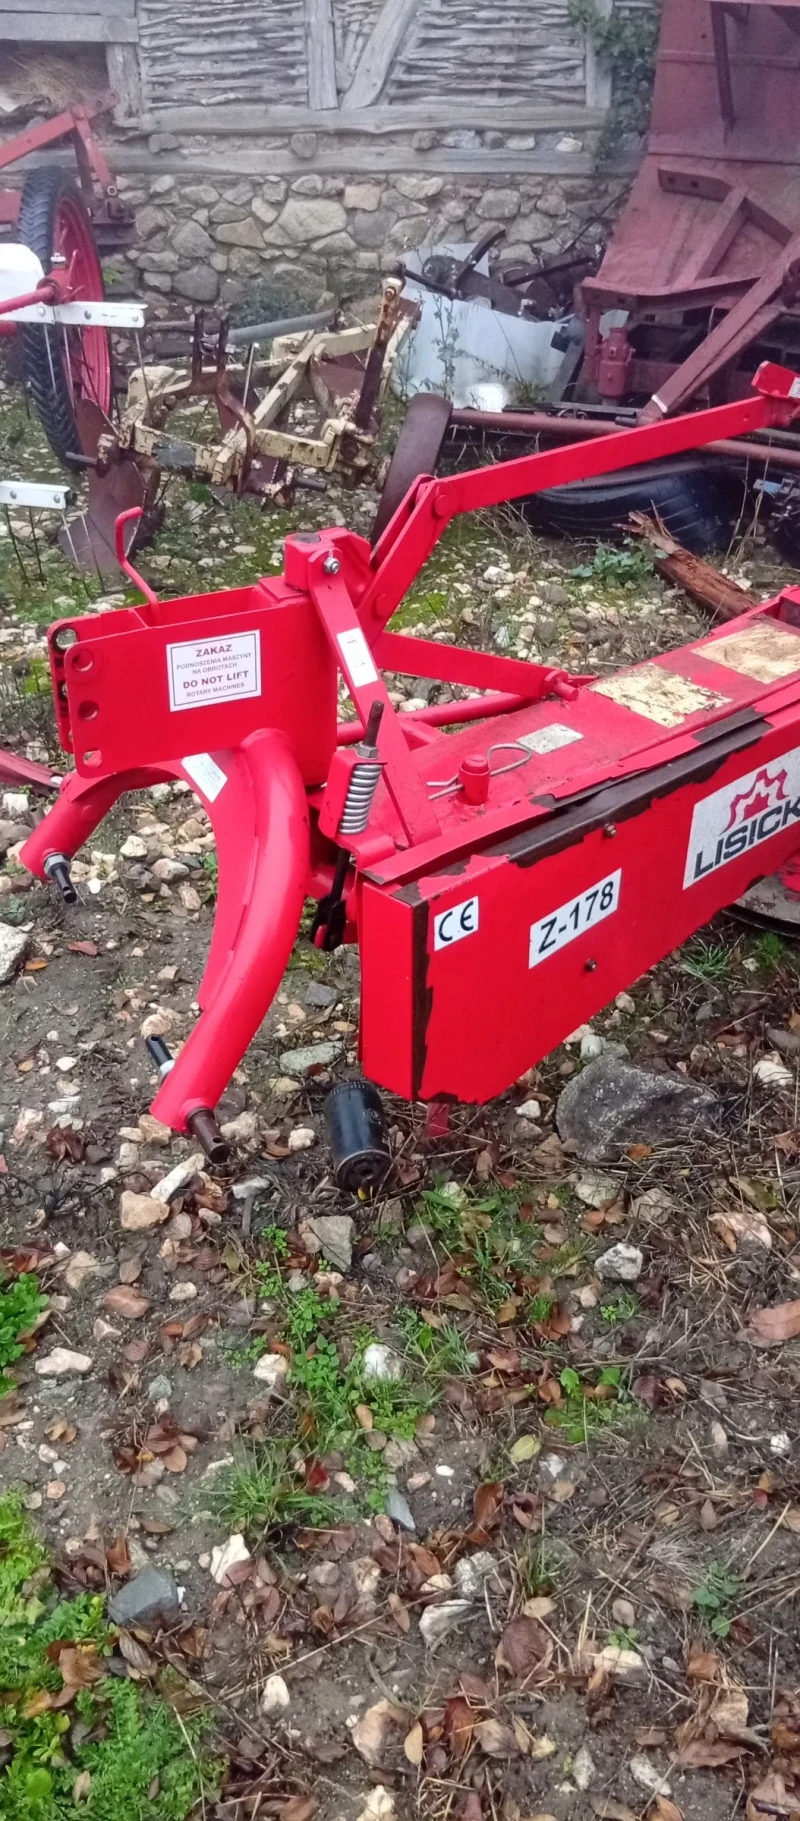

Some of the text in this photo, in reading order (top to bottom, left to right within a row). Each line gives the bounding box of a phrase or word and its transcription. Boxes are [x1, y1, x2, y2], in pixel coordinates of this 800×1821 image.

[195, 644, 232, 657] ZAKAZ
[222, 652, 252, 662] MASZYNY
[202, 662, 238, 673] OBROTACH
[183, 670, 249, 689] DO NOT LIFT
[212, 682, 245, 692] MACHINES
[693, 796, 800, 880] LISICK
[538, 881, 614, 954] Z-178
